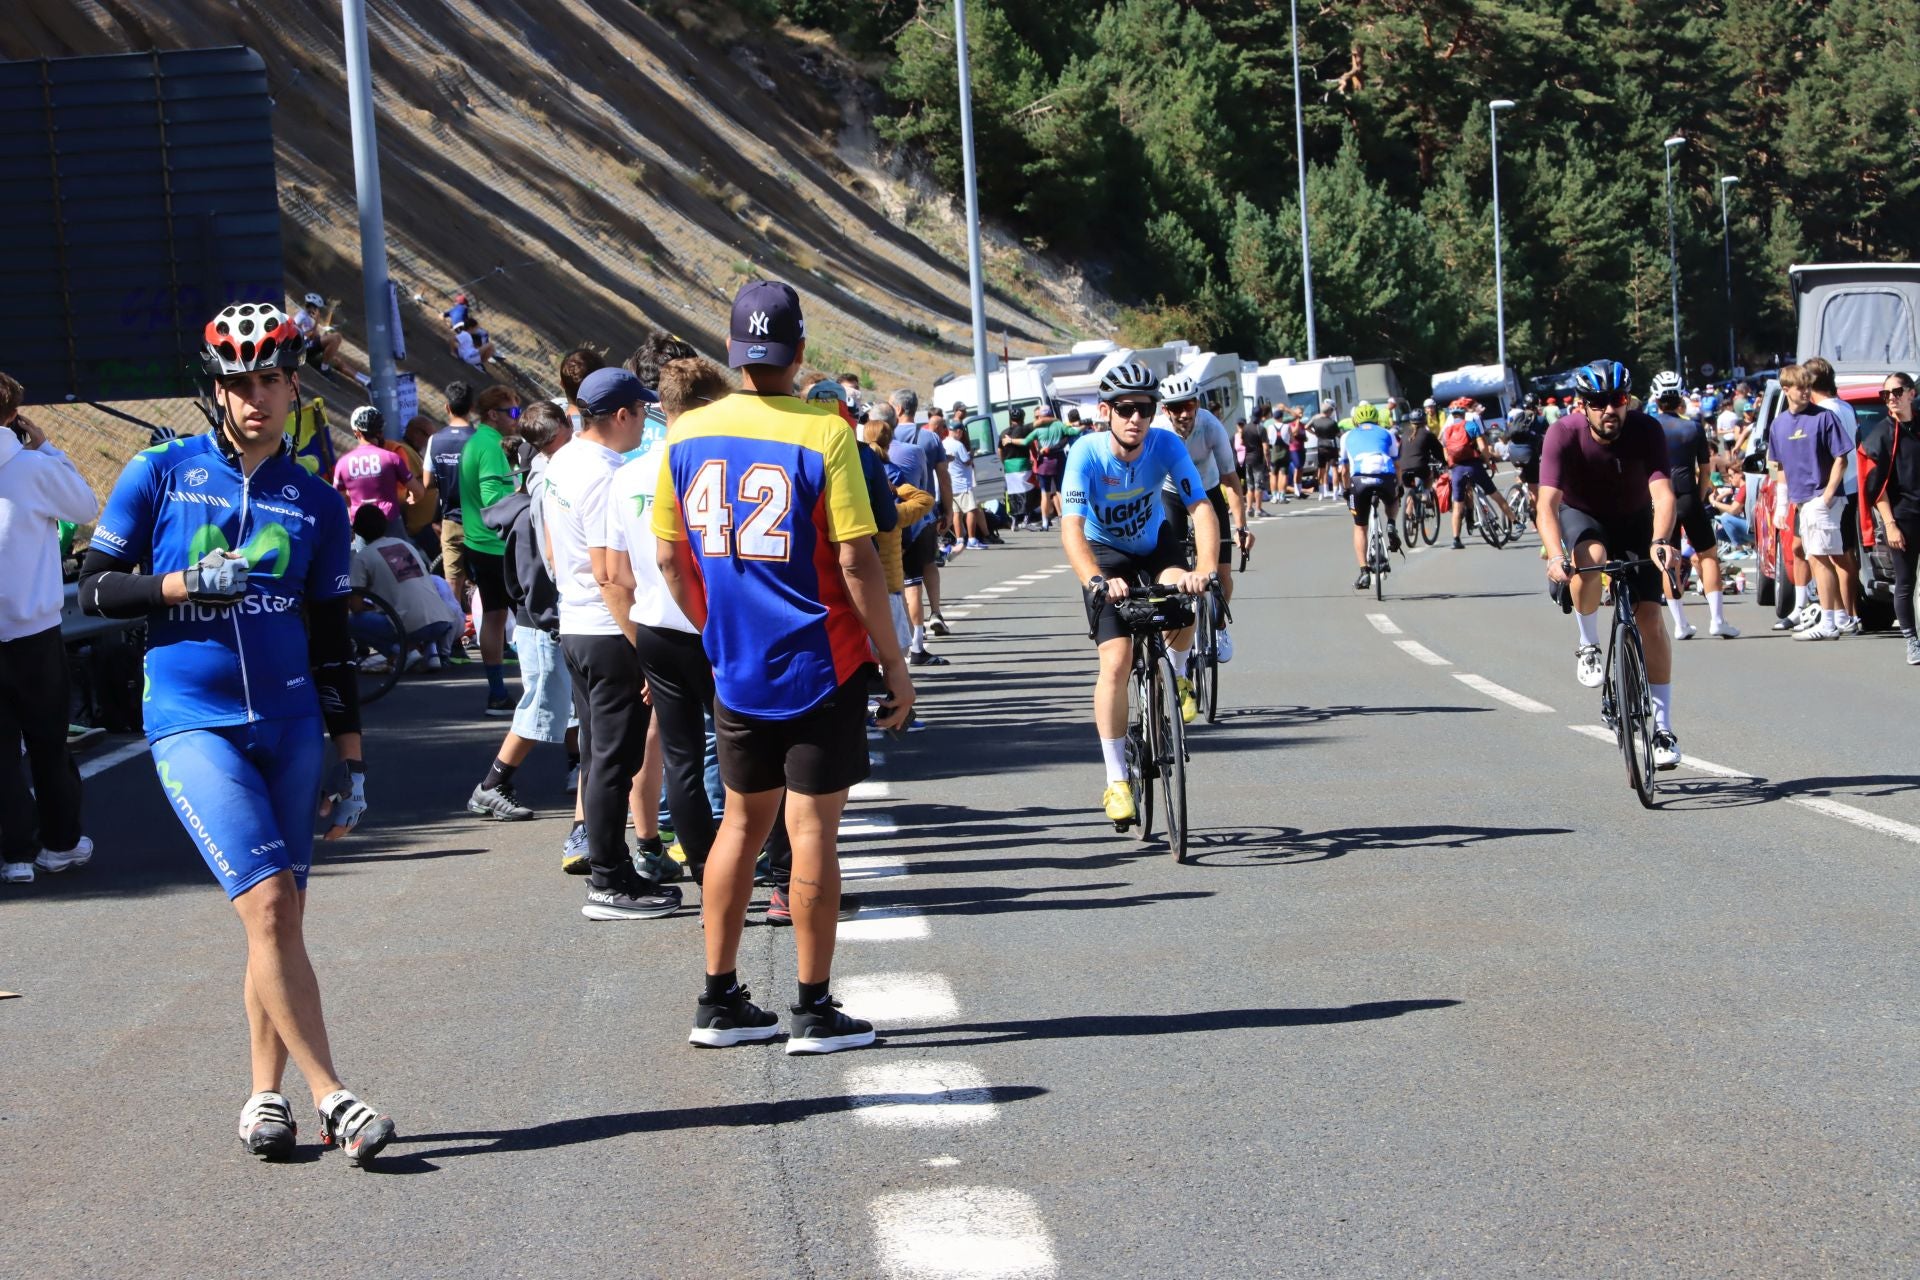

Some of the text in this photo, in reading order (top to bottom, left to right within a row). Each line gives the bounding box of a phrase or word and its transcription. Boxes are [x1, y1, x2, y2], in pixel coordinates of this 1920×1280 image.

[348, 454, 382, 477] CCB
[167, 490, 232, 509] CANYON
[683, 459, 792, 562] 42
[1094, 491, 1154, 525] LIGHT
[256, 502, 314, 526] ENDURA
[176, 796, 238, 878] movistar
[588, 891, 614, 904] HOKA
